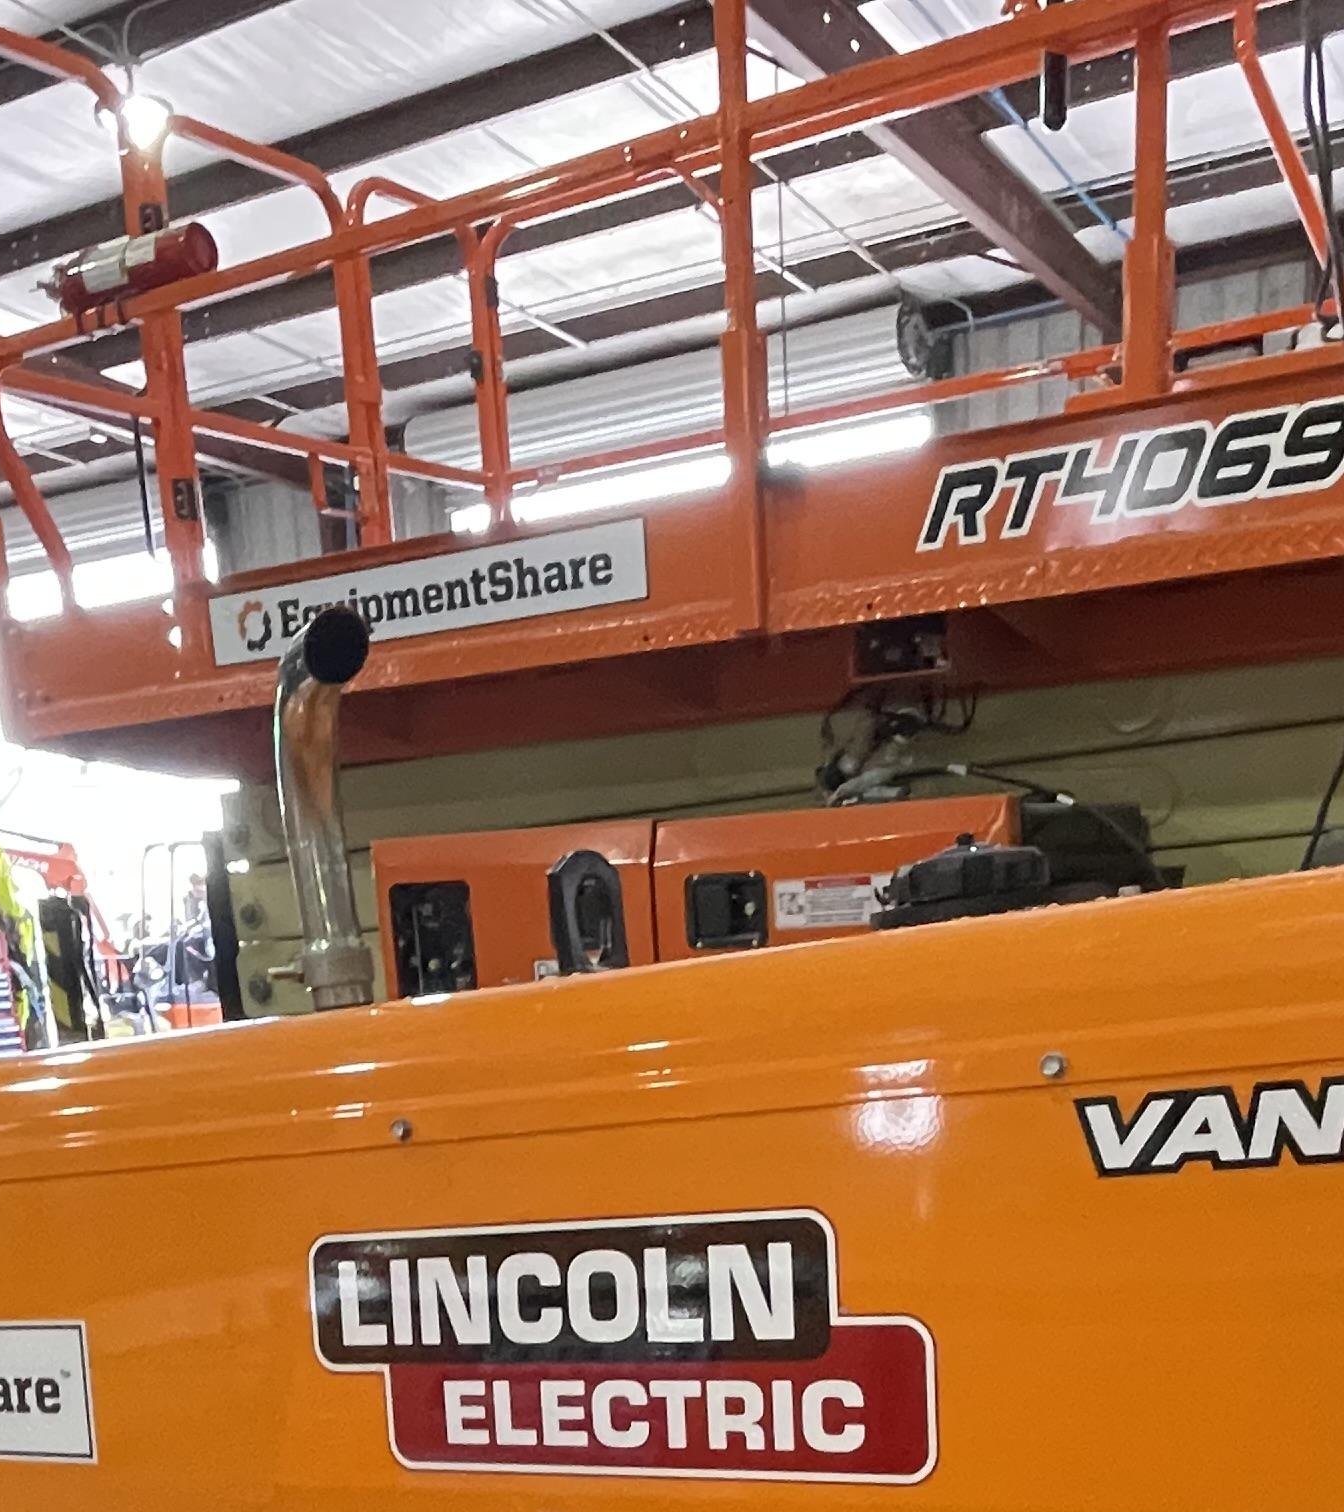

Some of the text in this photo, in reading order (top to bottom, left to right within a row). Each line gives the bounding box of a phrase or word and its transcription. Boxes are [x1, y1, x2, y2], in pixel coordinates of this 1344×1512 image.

[277, 550, 614, 638] EipmentShare
[336, 1241, 796, 1348] LINCOLN
[442, 1379, 866, 1454] ELECTRIC
